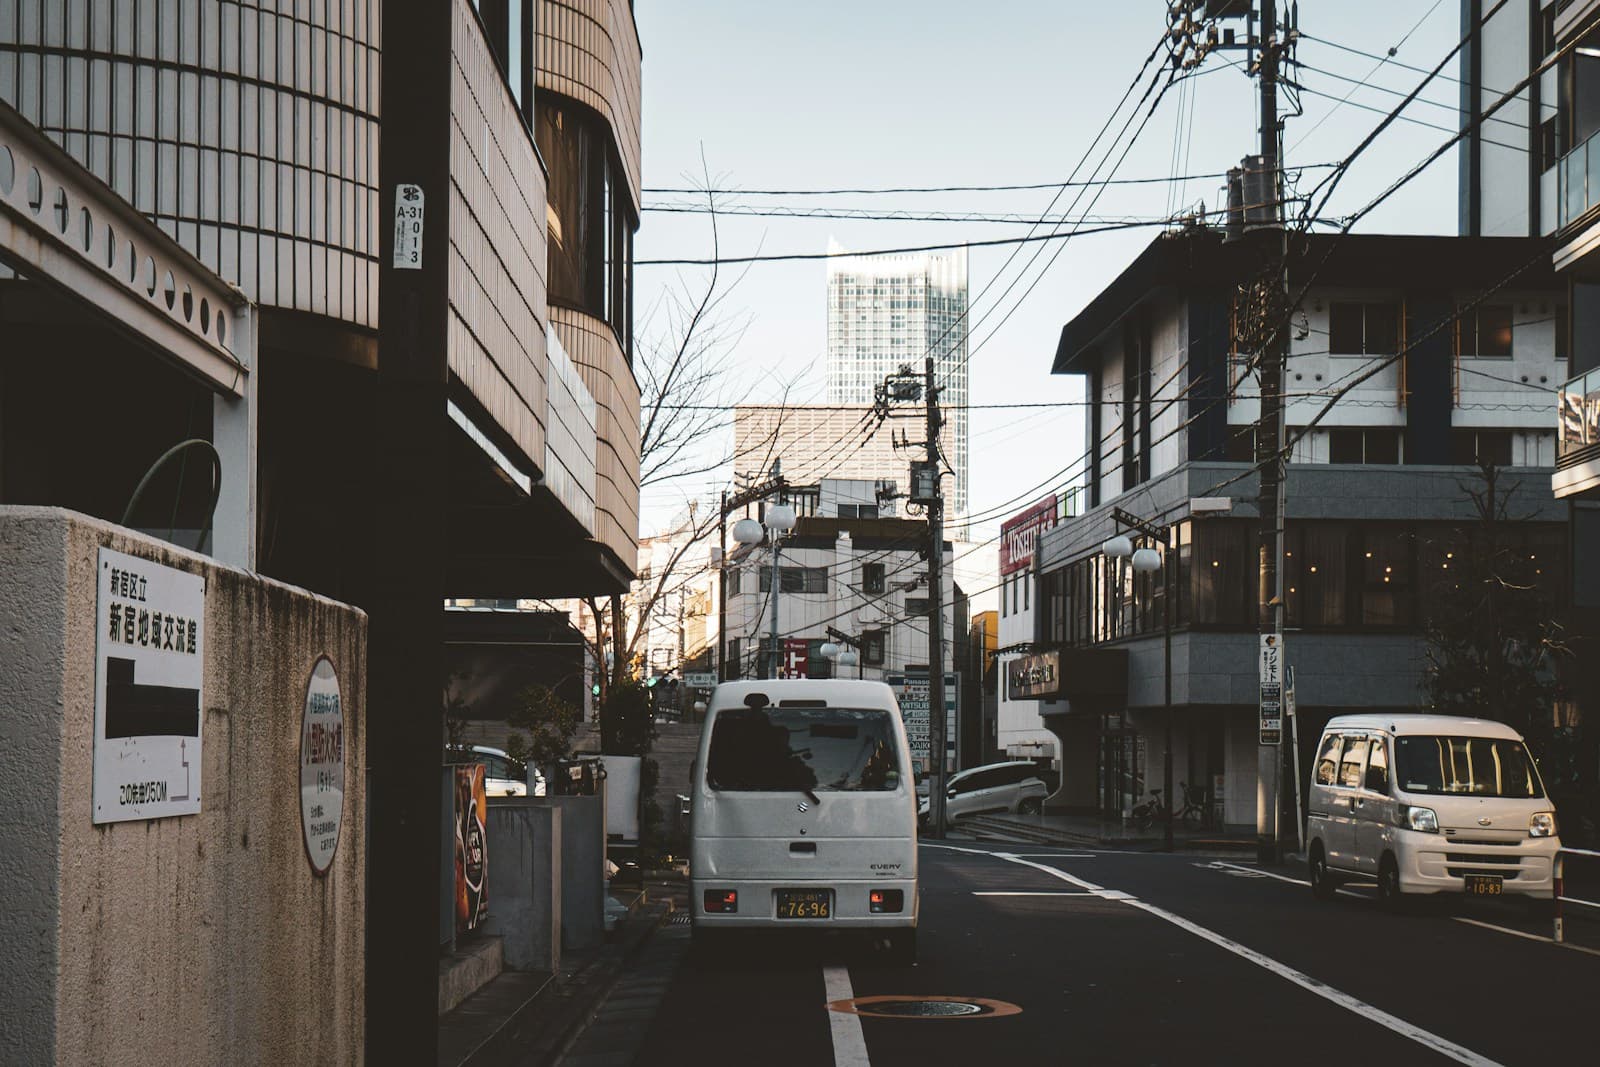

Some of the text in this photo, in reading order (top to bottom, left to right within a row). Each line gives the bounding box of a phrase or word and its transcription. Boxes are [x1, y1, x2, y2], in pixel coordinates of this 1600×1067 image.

[396, 206, 423, 219] A-31
[110, 567, 147, 602] 新宿区立
[109, 601, 197, 654] 新宿地域交流館
[901, 701, 930, 709] MITSUB
[119, 780, 168, 806] この先曲り50M
[788, 902, 827, 917] 76-96
